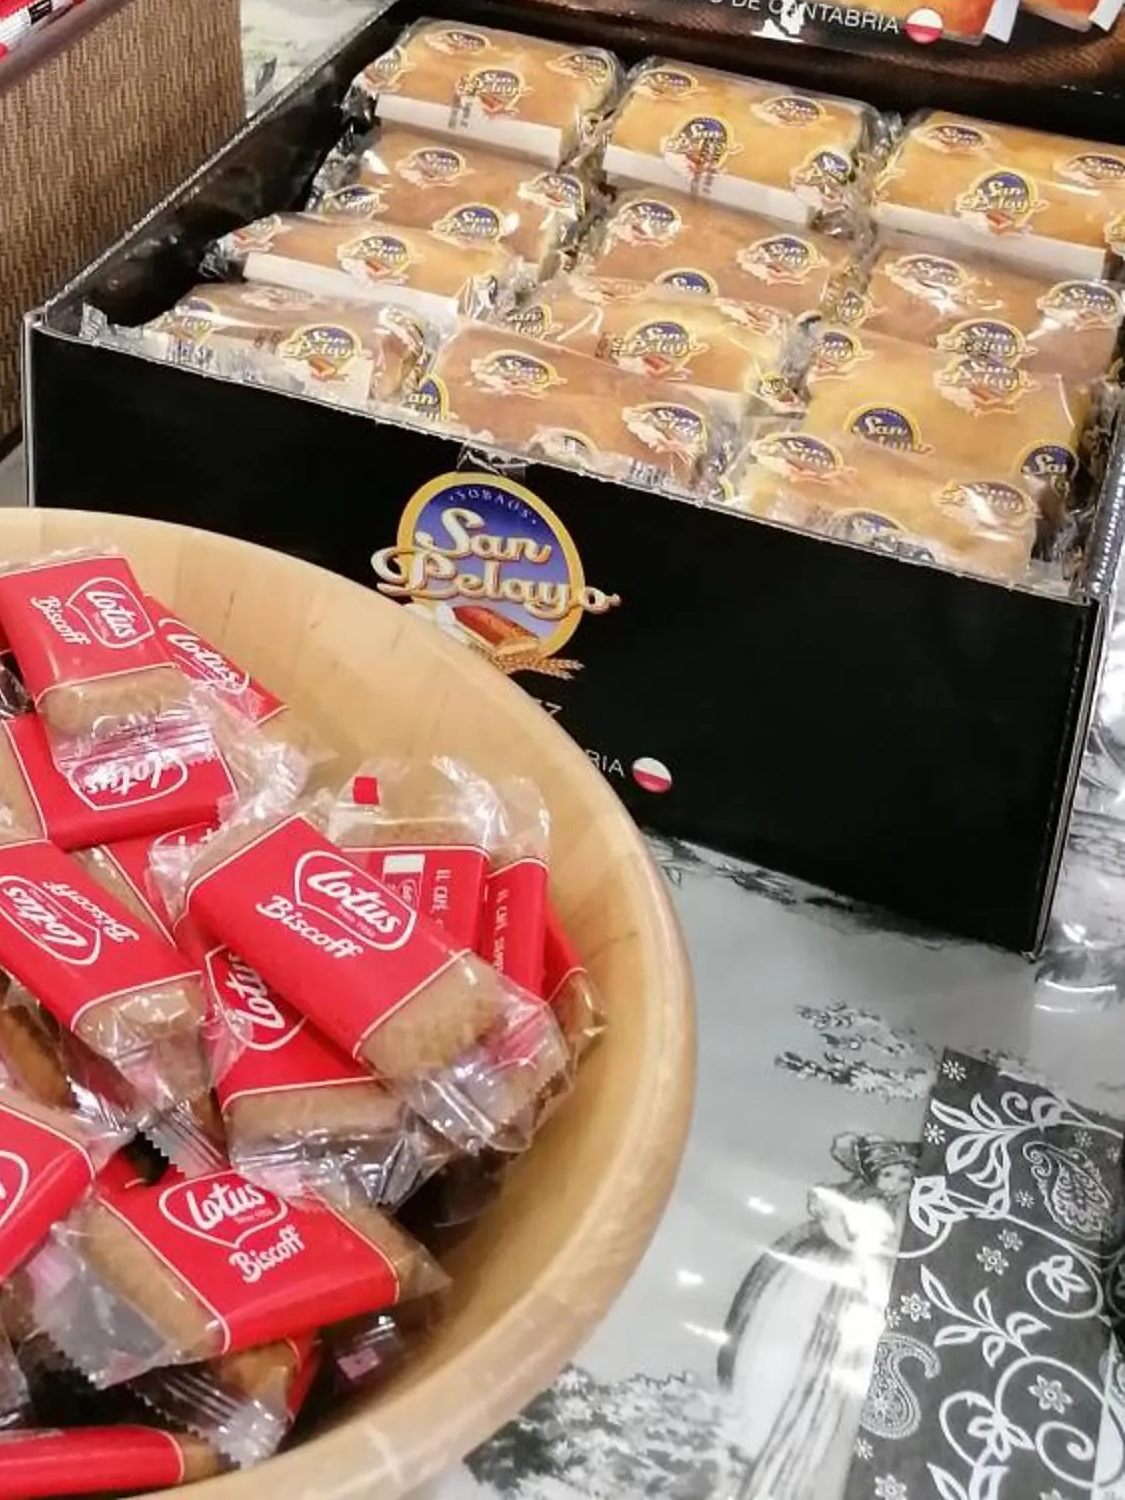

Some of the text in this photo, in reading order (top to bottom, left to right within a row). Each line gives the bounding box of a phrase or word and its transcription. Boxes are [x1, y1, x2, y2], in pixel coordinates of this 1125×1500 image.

[415, 507, 552, 564] San
[370, 547, 621, 621] Pelayo
[30, 595, 91, 646] Biscoff
[84, 590, 138, 639] Lotus
[167, 632, 241, 689] Lotus
[3, 886, 89, 948] Lotus
[41, 880, 140, 943] Biscoff
[256, 894, 363, 959] Biscoff
[307, 867, 402, 935] Lotus
[187, 1180, 266, 1230] Lotus
[229, 1225, 305, 1283] Biscoff
